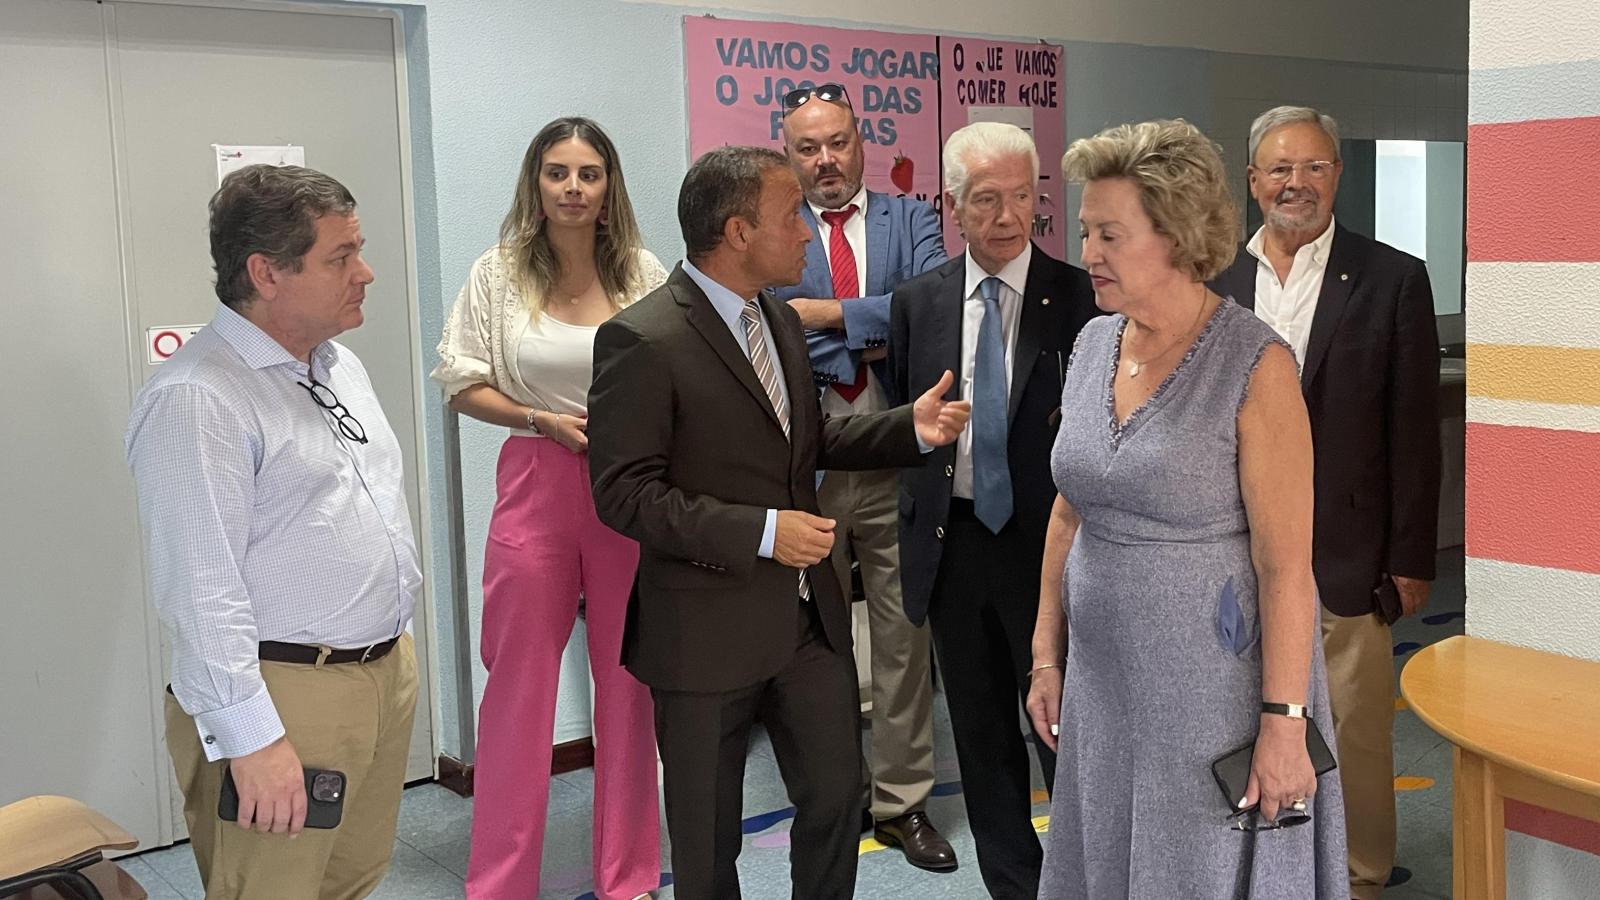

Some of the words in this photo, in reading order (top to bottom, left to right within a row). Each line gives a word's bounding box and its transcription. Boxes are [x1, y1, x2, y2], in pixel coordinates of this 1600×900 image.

[716, 38, 829, 72] VAMOS
[841, 47, 939, 80] JOGAR
[953, 43, 964, 72] O
[1016, 49, 1057, 77] VAMOS
[716, 75, 738, 105] O
[863, 85, 922, 114] DAS
[957, 79, 1005, 105] COMER
[1019, 80, 1057, 108] HOJE
